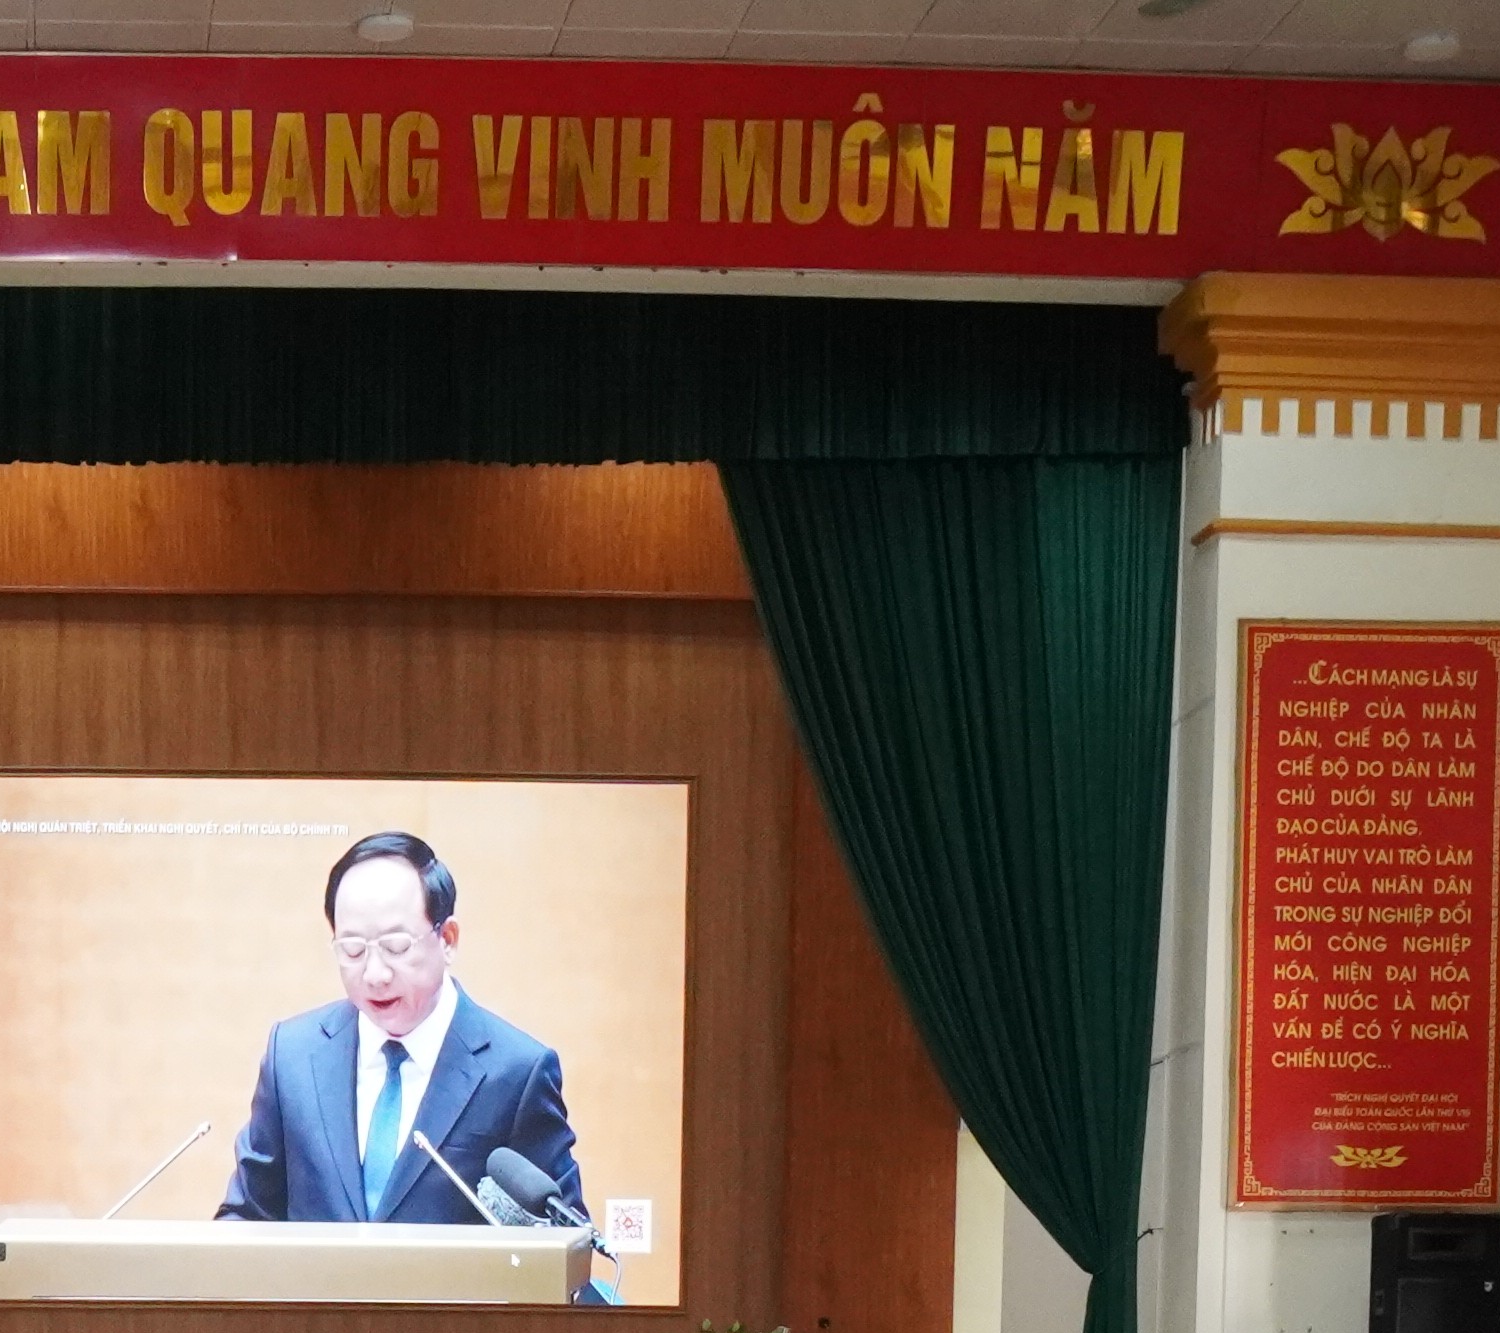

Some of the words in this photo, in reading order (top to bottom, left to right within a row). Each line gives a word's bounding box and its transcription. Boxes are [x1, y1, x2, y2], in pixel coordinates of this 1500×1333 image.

[143, 108, 438, 226] QUANG
[473, 115, 671, 220] VINH
[701, 93, 955, 228] MUÔN
[981, 101, 1184, 235] NĂM
[1293, 660, 1367, 686] ...CÁCH
[1372, 670, 1429, 689] MẠNG
[1433, 666, 1453, 686] LÀ
[1457, 671, 1478, 689] SỰ
[1280, 698, 1349, 720] NGHIỆP
[1366, 696, 1405, 718] CỦA
[1423, 700, 1476, 719] NHÂN
[1279, 727, 1321, 748] DÂN,
[1335, 726, 1369, 748] CHẾ
[1382, 728, 1410, 751] ĐỘ
[1423, 732, 1442, 748] TA
[1455, 728, 1475, 748] LÀ
[1278, 755, 1312, 776] CHẾ
[1321, 757, 1349, 779] ĐỘ
[1357, 761, 1384, 777] DO
[1392, 758, 1430, 777] DÂN
[1439, 757, 1475, 777] LÀM
[1277, 784, 1315, 805] CHỦ
[1331, 784, 1375, 807] DƯỚI
[1391, 790, 1412, 810] SỰ
[1428, 788, 1473, 807] LÃNH
[1277, 818, 1318, 838] ĐẠO
[1321, 813, 1359, 836] CỦA
[1363, 814, 1421, 836] ĐẢNG.
[1276, 843, 1320, 863] PHÁT
[1324, 848, 1358, 865] HUY
[1363, 849, 1393, 864] VAI
[1399, 845, 1431, 865] TRÒ
[1436, 845, 1472, 865] LÀM
[1275, 871, 1312, 893] CHỦ
[1323, 872, 1361, 894] CỦA
[1372, 875, 1423, 894] NHÂN
[1434, 875, 1471, 894] DÂN
